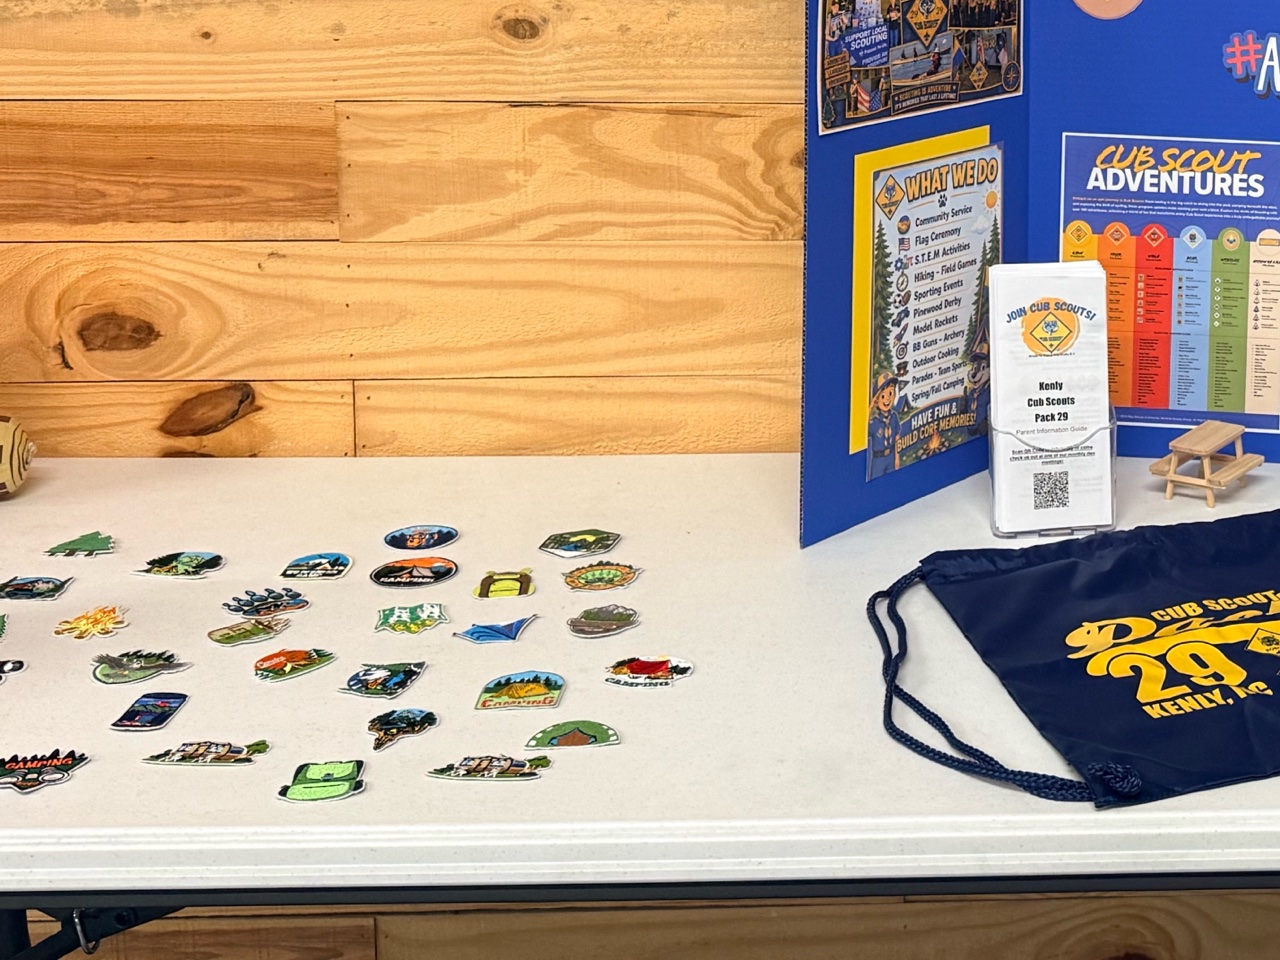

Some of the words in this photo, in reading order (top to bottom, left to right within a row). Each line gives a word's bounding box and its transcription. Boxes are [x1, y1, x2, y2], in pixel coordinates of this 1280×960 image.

[1095, 144, 1154, 172] CUB
[1157, 148, 1262, 174] SCOUT
[905, 164, 950, 202] WHAT
[951, 159, 976, 188] WE
[977, 157, 998, 184] DO
[1086, 168, 1264, 198] ADVENTURES
[915, 212, 950, 227] Community
[951, 205, 973, 218] Service
[915, 235, 929, 247] Flag
[930, 226, 962, 241] Ceremony
[1006, 306, 1027, 324] JOIN
[1029, 302, 1050, 313] CUB
[1039, 381, 1063, 391] Kenly
[1027, 398, 1044, 407] Cub
[1046, 396, 1075, 406] Scouts
[1035, 413, 1055, 423] Pack
[1057, 412, 1068, 421] 29
[1151, 602, 1204, 622] CUB
[1108, 641, 1247, 704] 29
[1142, 688, 1235, 719] KENLY,
[5, 758, 72, 769] CAMPING
